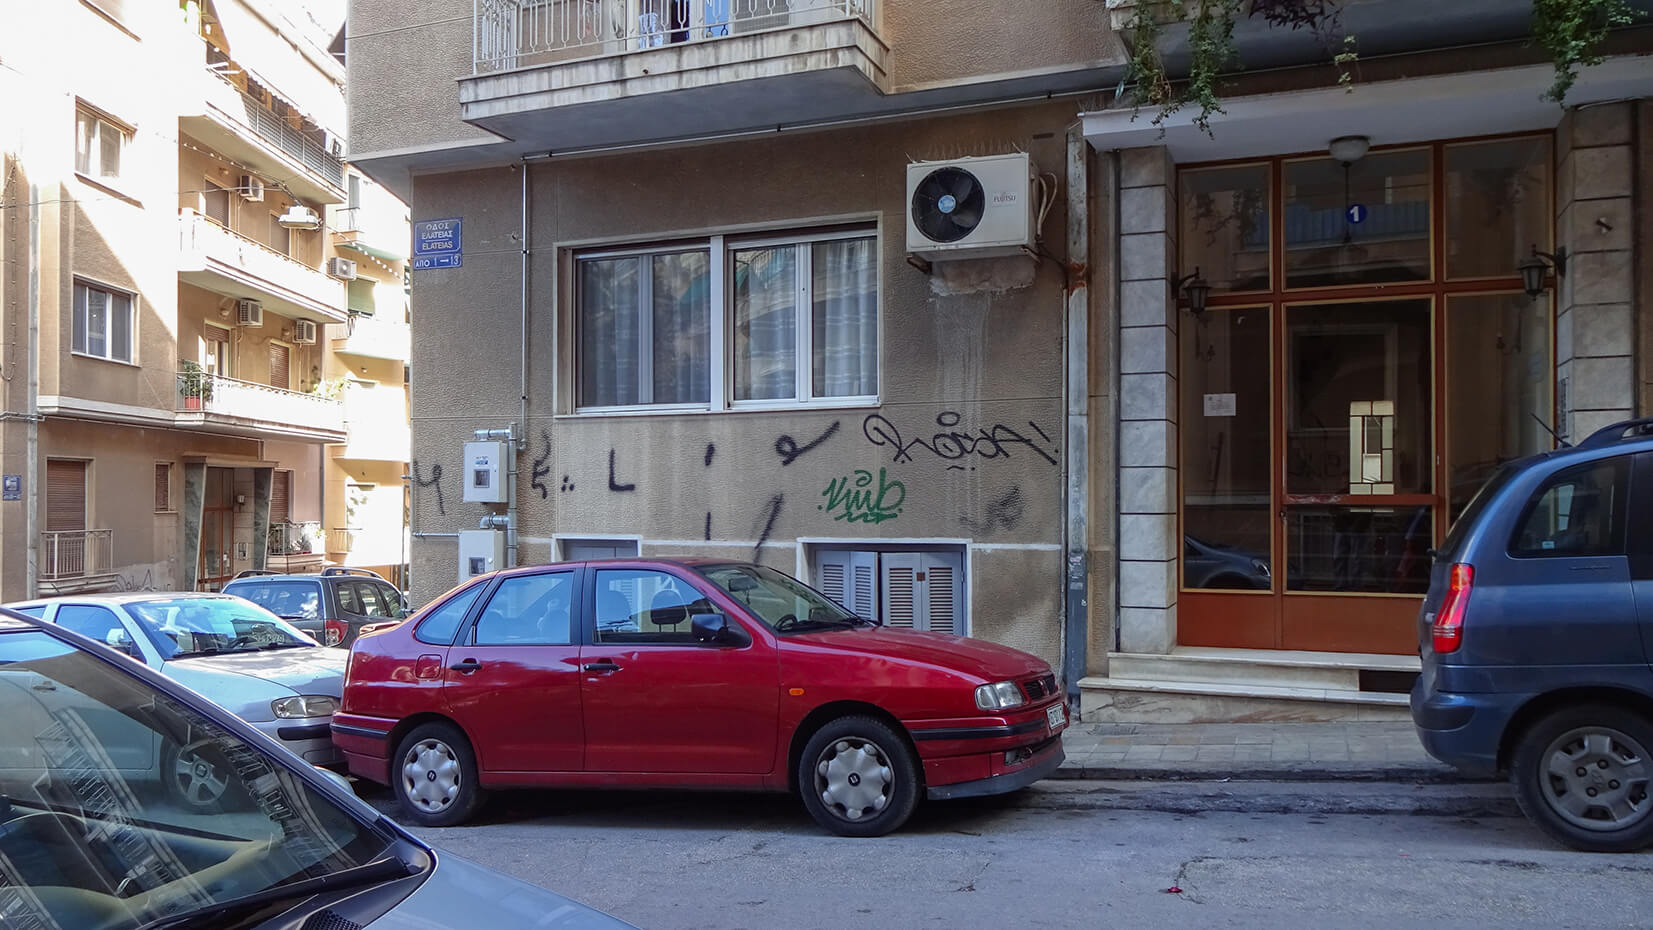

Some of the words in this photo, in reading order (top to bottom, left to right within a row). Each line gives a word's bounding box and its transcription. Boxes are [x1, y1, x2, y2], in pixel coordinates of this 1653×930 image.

[1350, 206, 1359, 221] 1
[422, 241, 453, 250] ELATEIAS
[415, 259, 430, 267] ΑΠΟ
